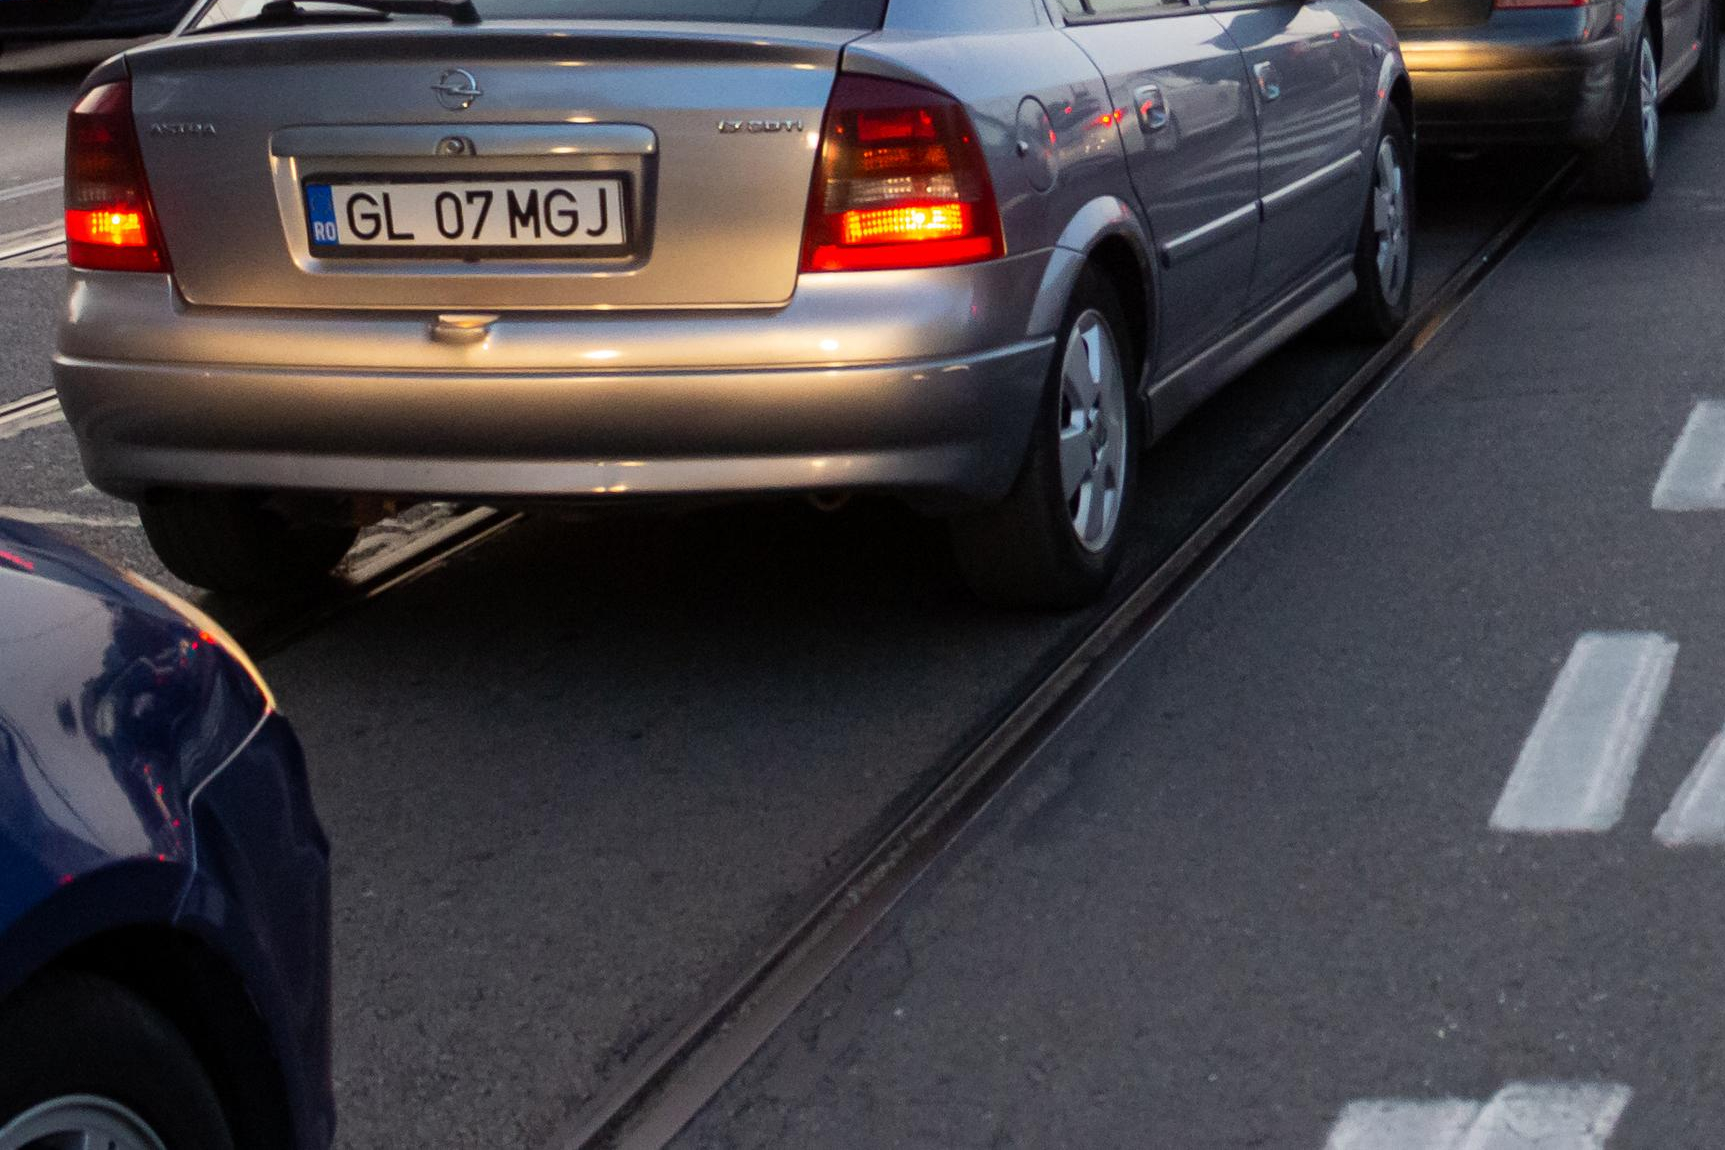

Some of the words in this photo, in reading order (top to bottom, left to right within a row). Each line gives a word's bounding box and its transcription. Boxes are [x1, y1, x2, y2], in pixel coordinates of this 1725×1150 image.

[313, 221, 336, 243] RO
[346, 192, 415, 240] GL
[434, 190, 494, 240] 07
[506, 187, 608, 239] MGJ
